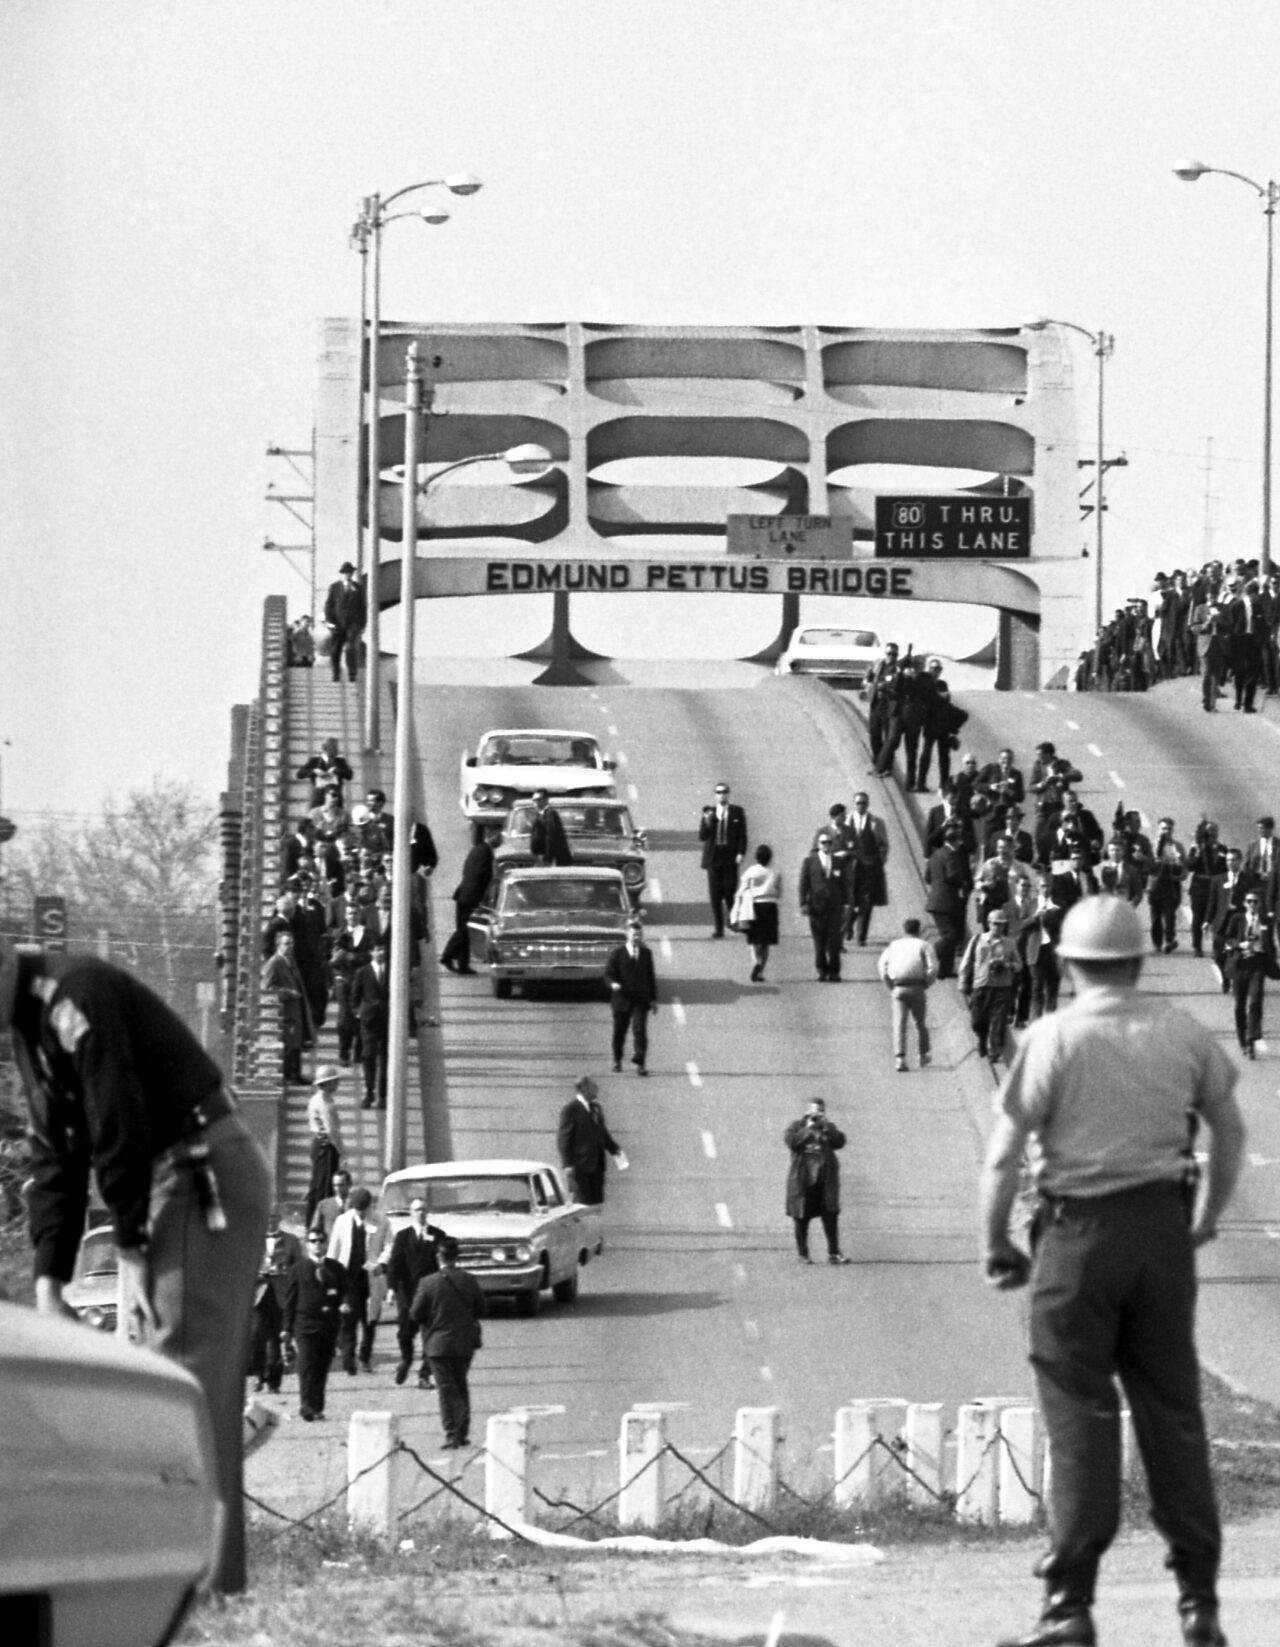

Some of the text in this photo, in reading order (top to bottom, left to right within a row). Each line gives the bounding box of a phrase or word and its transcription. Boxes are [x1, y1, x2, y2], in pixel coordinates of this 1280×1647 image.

[749, 516, 831, 530] LEFT TURN
[898, 506, 921, 524] 80
[769, 531, 807, 543] LANE
[884, 532, 1019, 549] THIS LANE
[487, 562, 913, 596] EDMUND PETTUS BRIDGE
